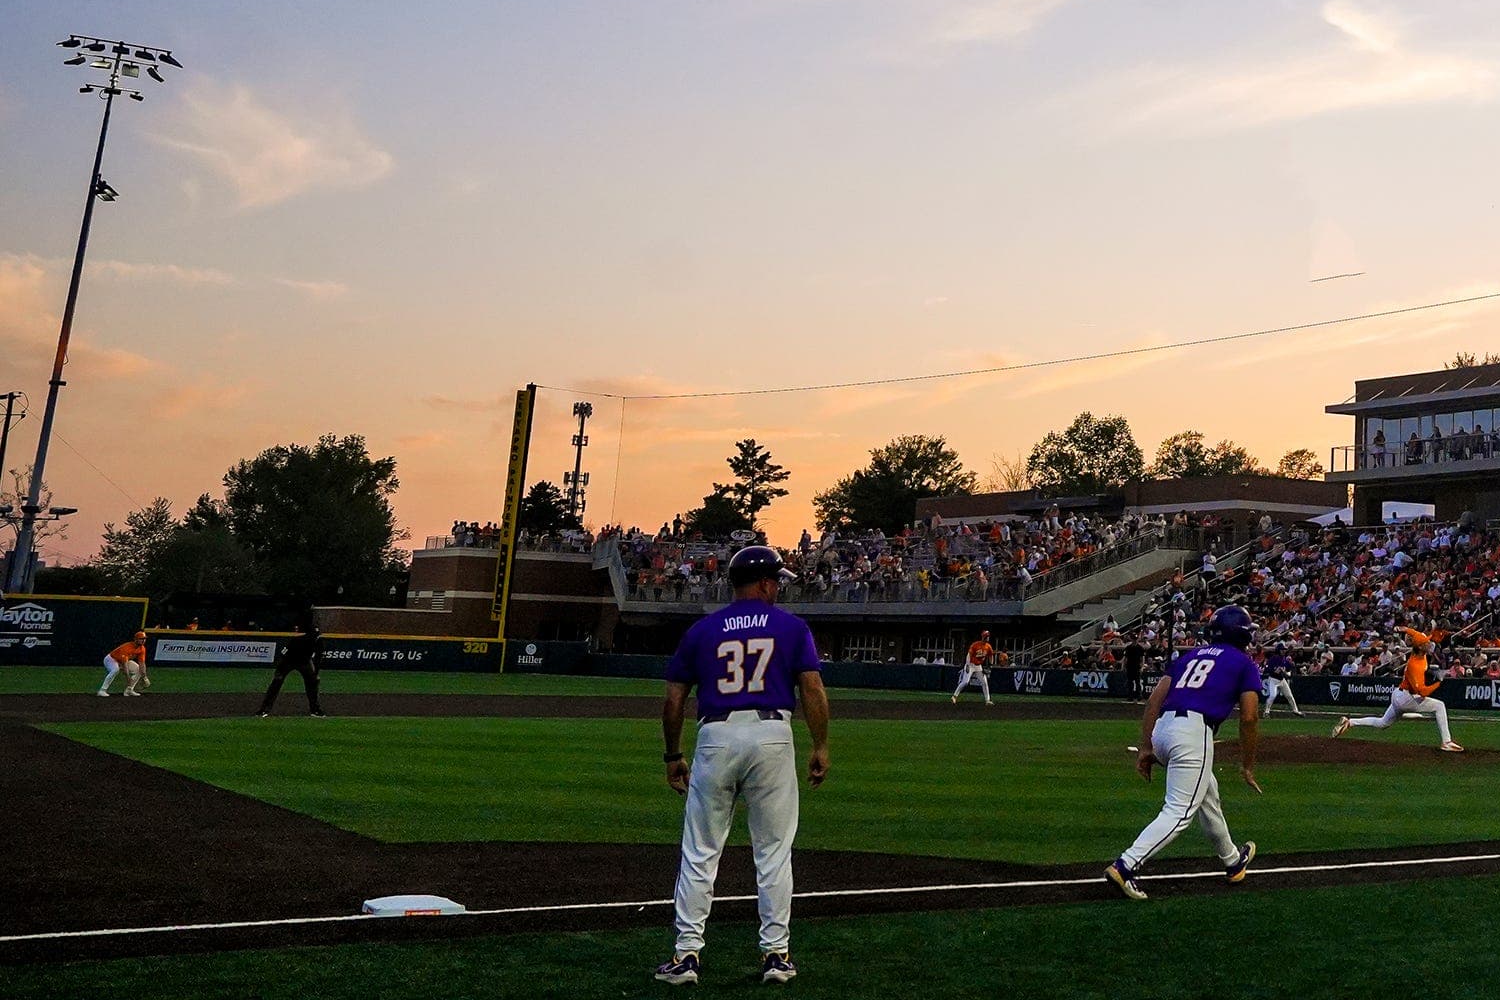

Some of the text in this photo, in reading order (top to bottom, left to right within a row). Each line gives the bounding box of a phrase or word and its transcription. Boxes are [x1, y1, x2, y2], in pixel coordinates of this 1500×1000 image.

[0, 606, 54, 625] layton
[722, 614, 769, 633] JORDAN
[20, 621, 52, 630] homes
[162, 643, 270, 654] Farm Bureau INSURANCE
[357, 648, 389, 660] Turns
[392, 650, 405, 660] To
[407, 650, 423, 661] Us
[463, 642, 488, 654] 320
[517, 655, 543, 664] Hiller
[716, 637, 775, 695] 37
[1025, 670, 1047, 687] RJV
[1081, 671, 1110, 689] FOX
[1175, 658, 1216, 689] 18
[1347, 683, 1374, 694] Modern
[1465, 685, 1492, 701] FOOD
